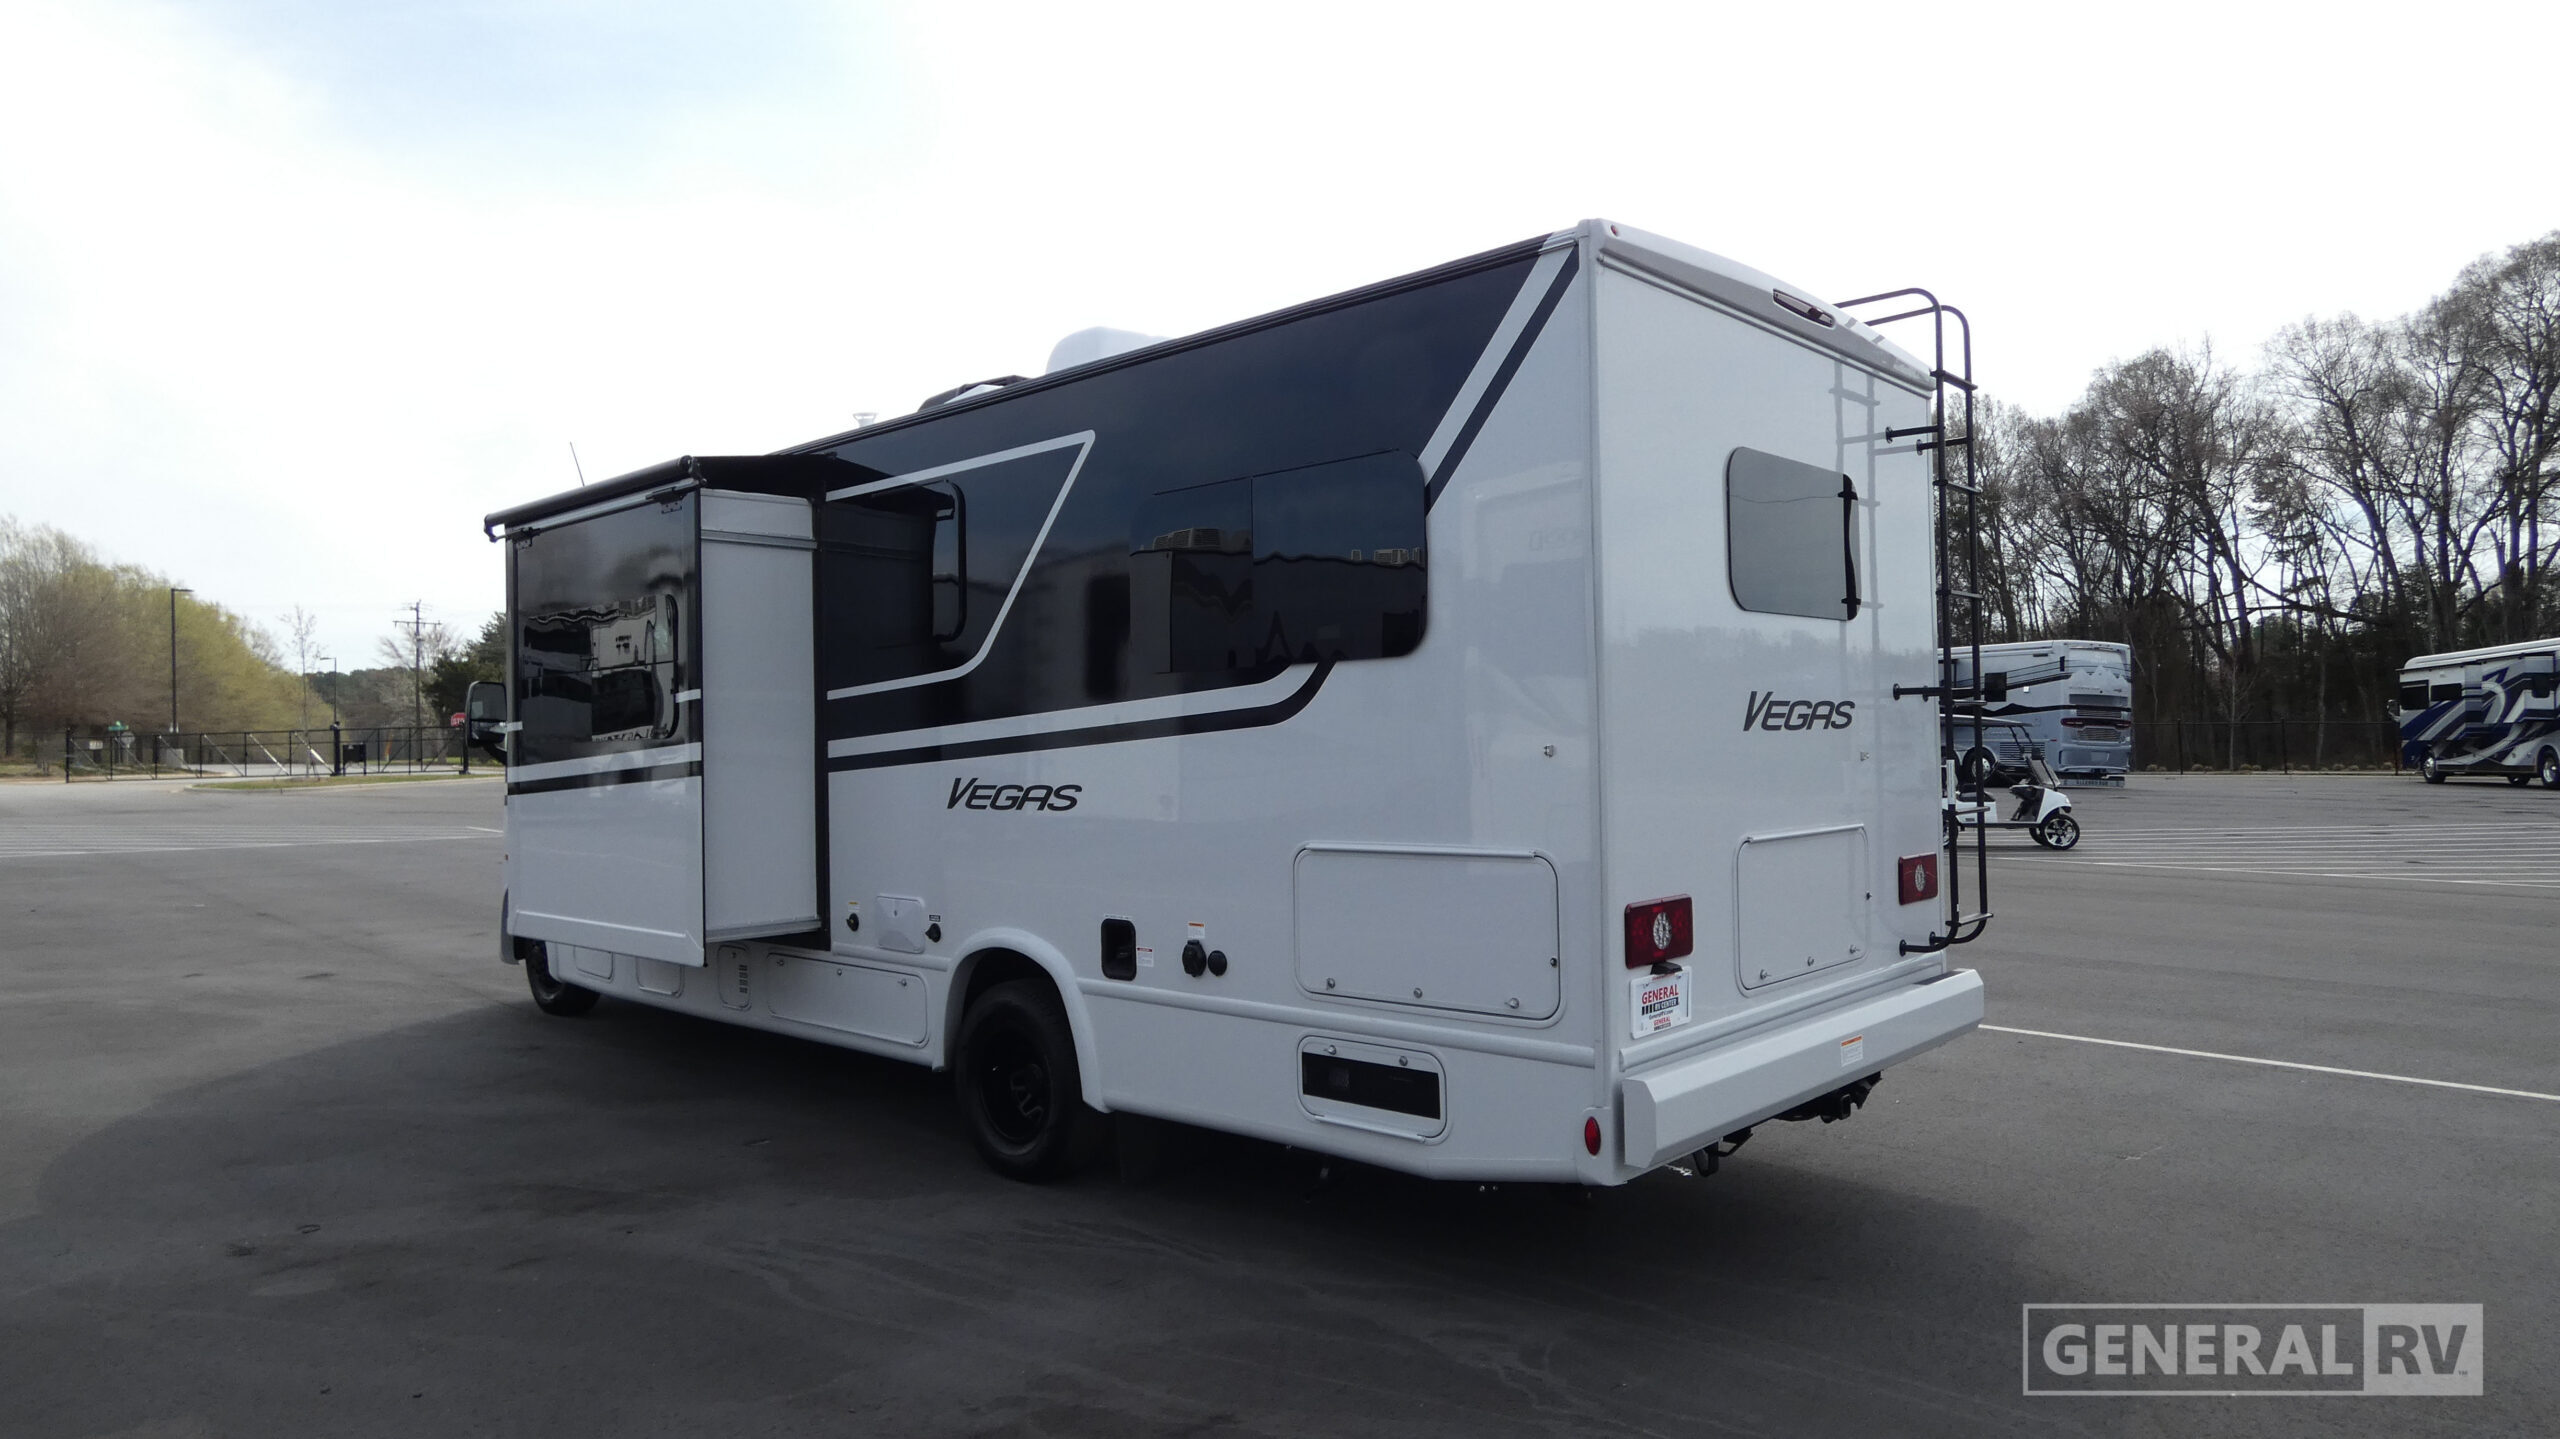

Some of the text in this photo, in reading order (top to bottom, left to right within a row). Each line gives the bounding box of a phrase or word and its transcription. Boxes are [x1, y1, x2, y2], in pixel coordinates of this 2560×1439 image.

[1743, 691, 1856, 732] VEGAS
[947, 777, 1083, 811] VEGAS
[1641, 984, 1679, 1005] GENERAL
